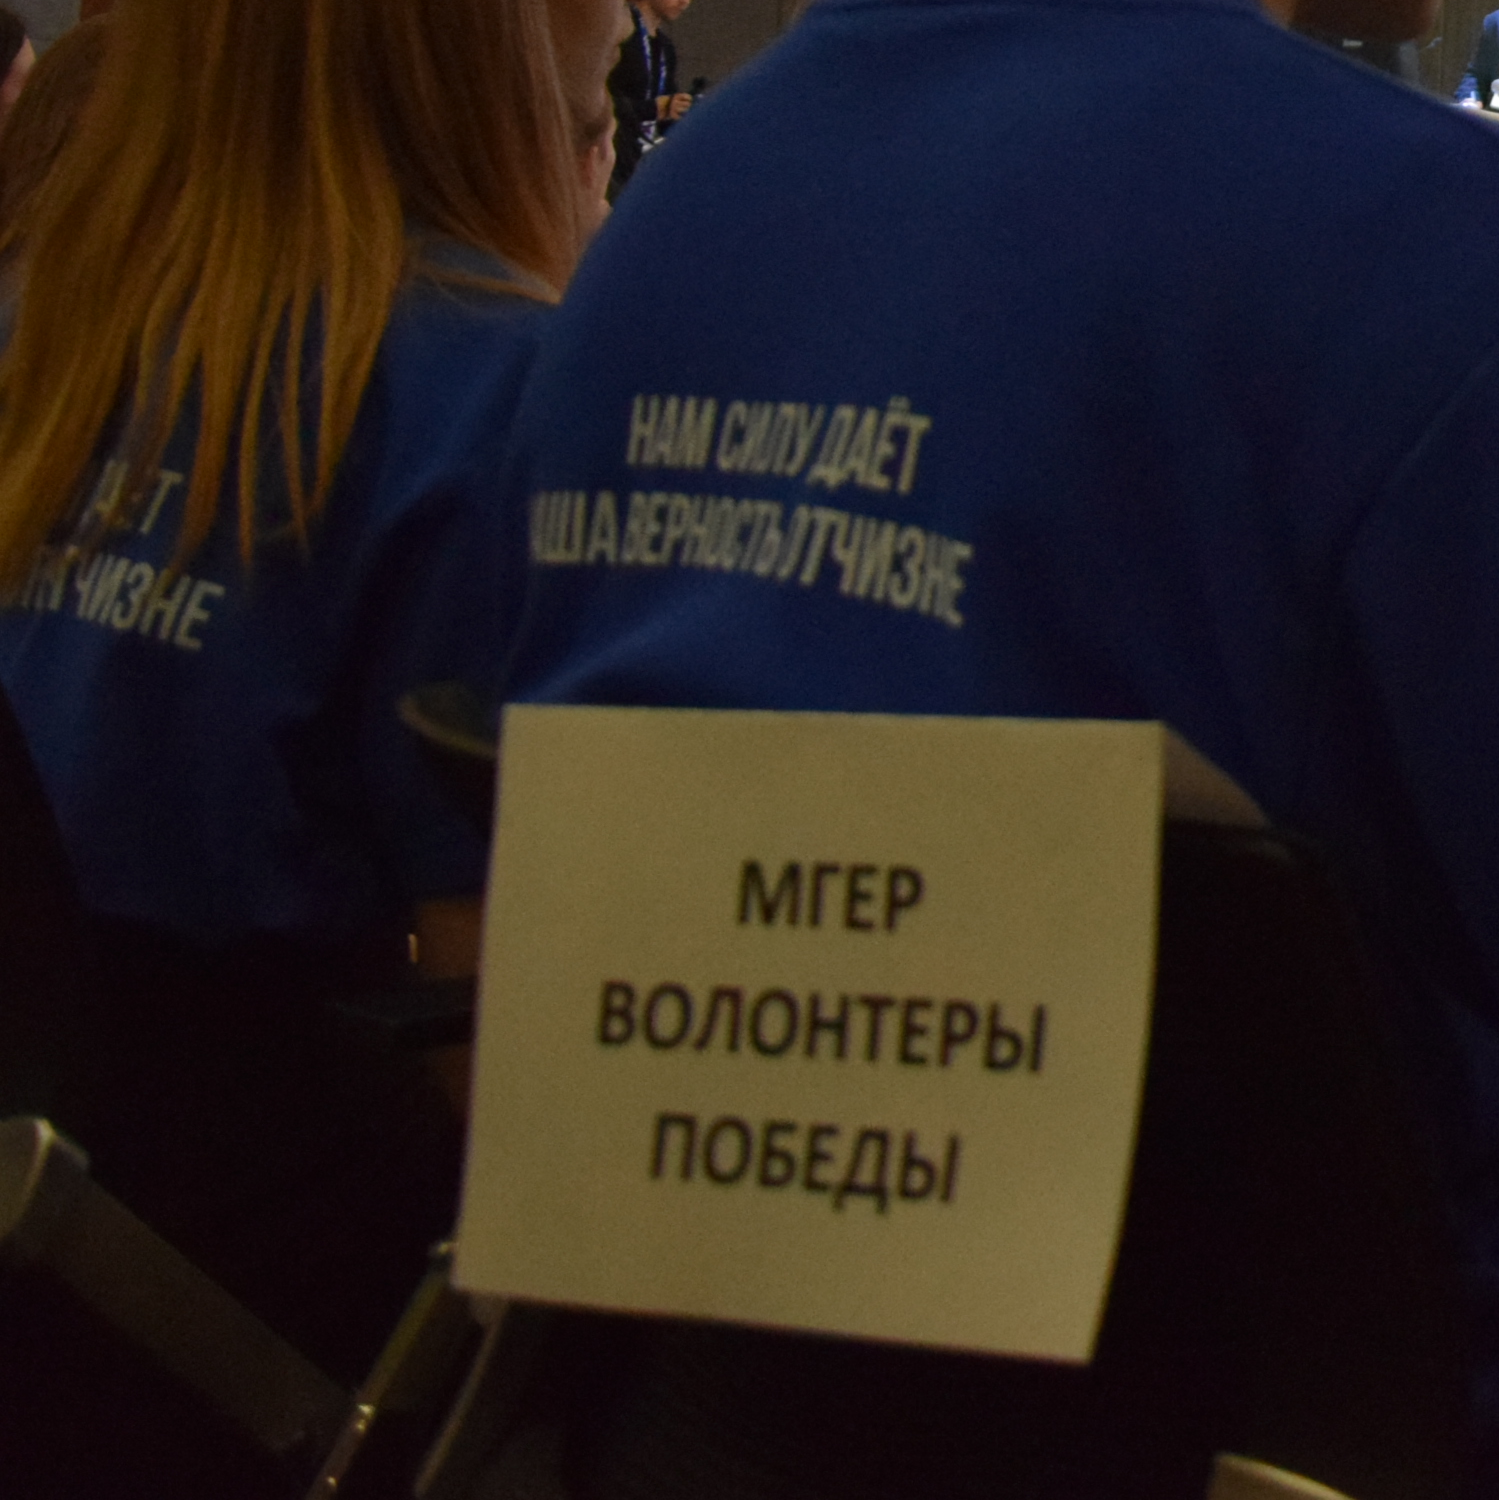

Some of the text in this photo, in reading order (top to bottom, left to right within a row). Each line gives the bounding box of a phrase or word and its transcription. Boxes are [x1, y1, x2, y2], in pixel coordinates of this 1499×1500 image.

[625, 392, 718, 470] НАМ
[805, 394, 932, 496] ДАЁТ
[735, 858, 926, 934] МГЕР
[595, 980, 1048, 1075] ВОЛОНТЕРЫ
[650, 1109, 962, 1216] ПОБЕДЫ
